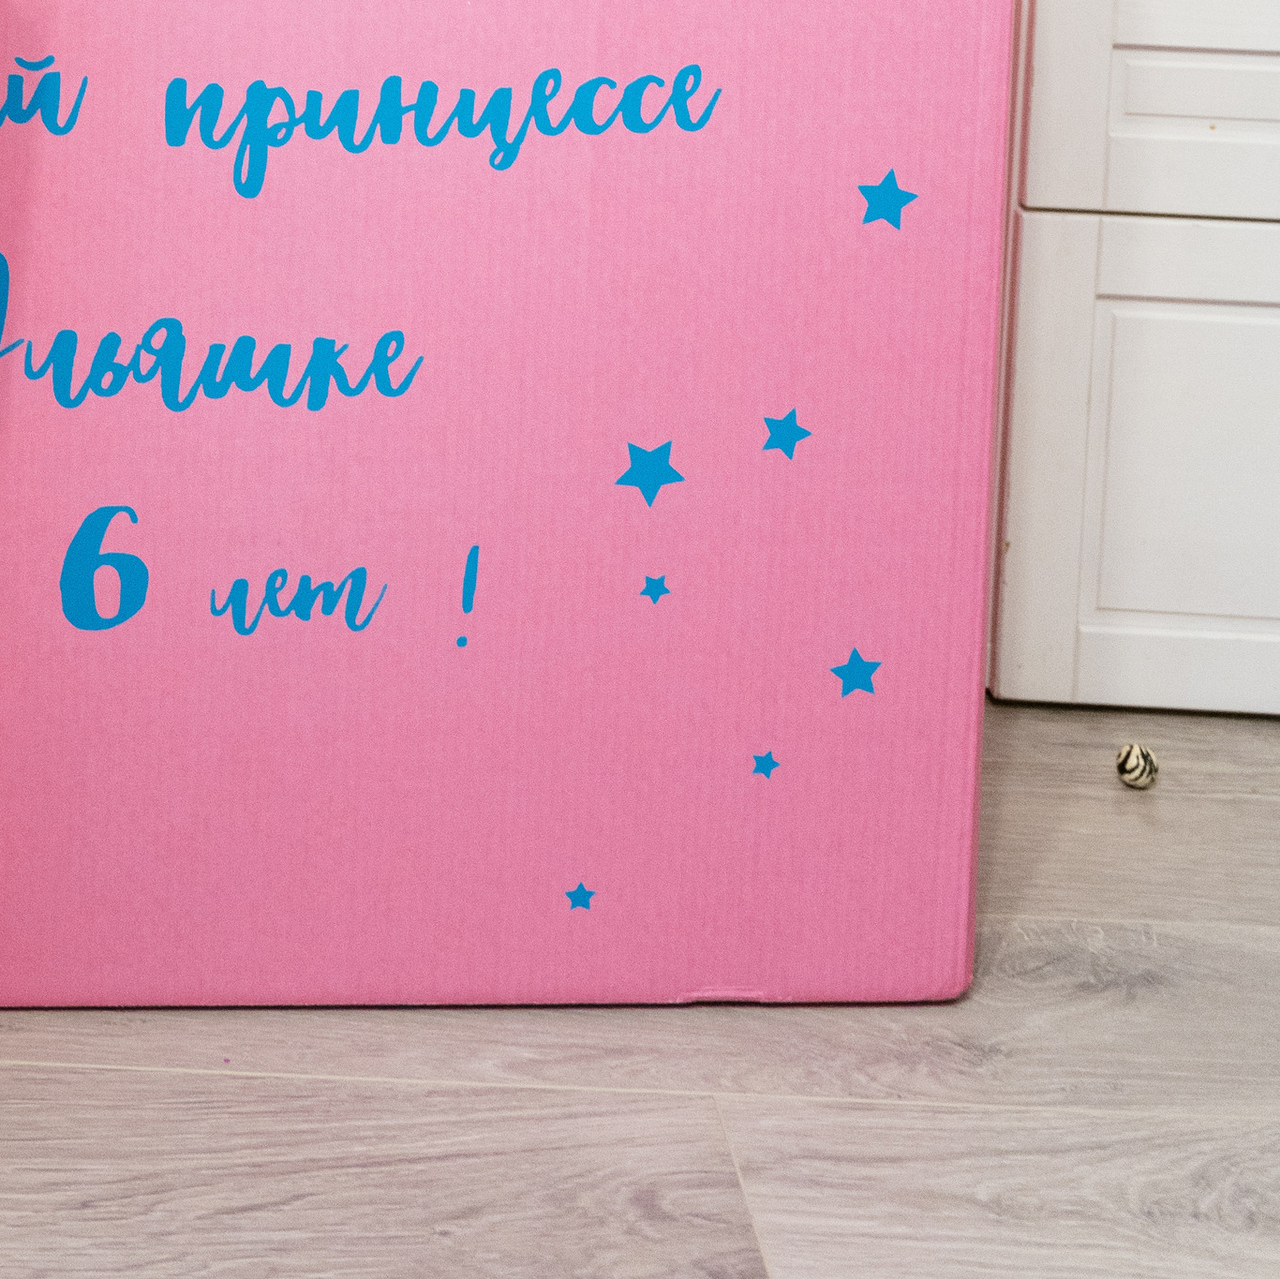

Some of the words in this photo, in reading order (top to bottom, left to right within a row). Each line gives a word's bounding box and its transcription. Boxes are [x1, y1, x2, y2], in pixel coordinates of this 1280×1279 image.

[164, 64, 722, 199] принцессе
[59, 505, 150, 631] 6
[210, 566, 388, 636] лет
